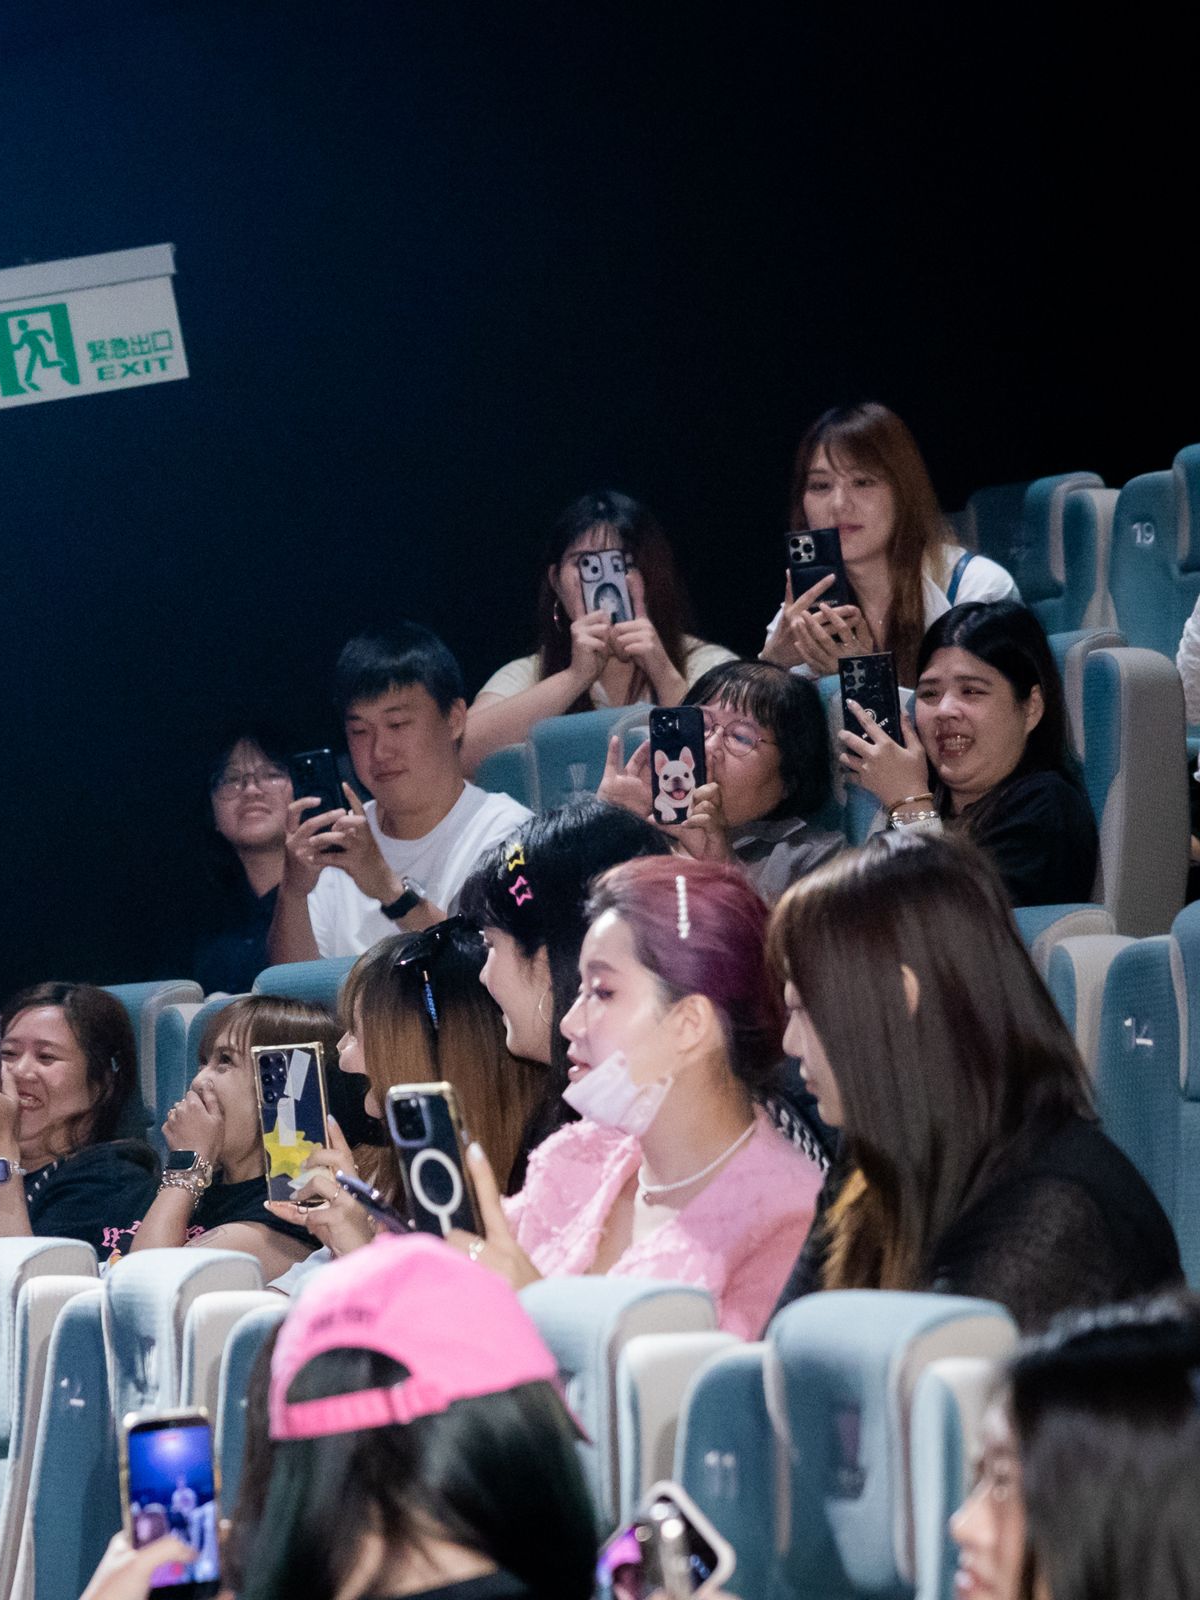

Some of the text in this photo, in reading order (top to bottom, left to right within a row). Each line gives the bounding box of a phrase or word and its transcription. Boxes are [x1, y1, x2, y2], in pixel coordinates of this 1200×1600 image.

[87, 330, 173, 363] 緊急出口
[97, 356, 172, 380] EXIT
[1131, 521, 1155, 545] 19
